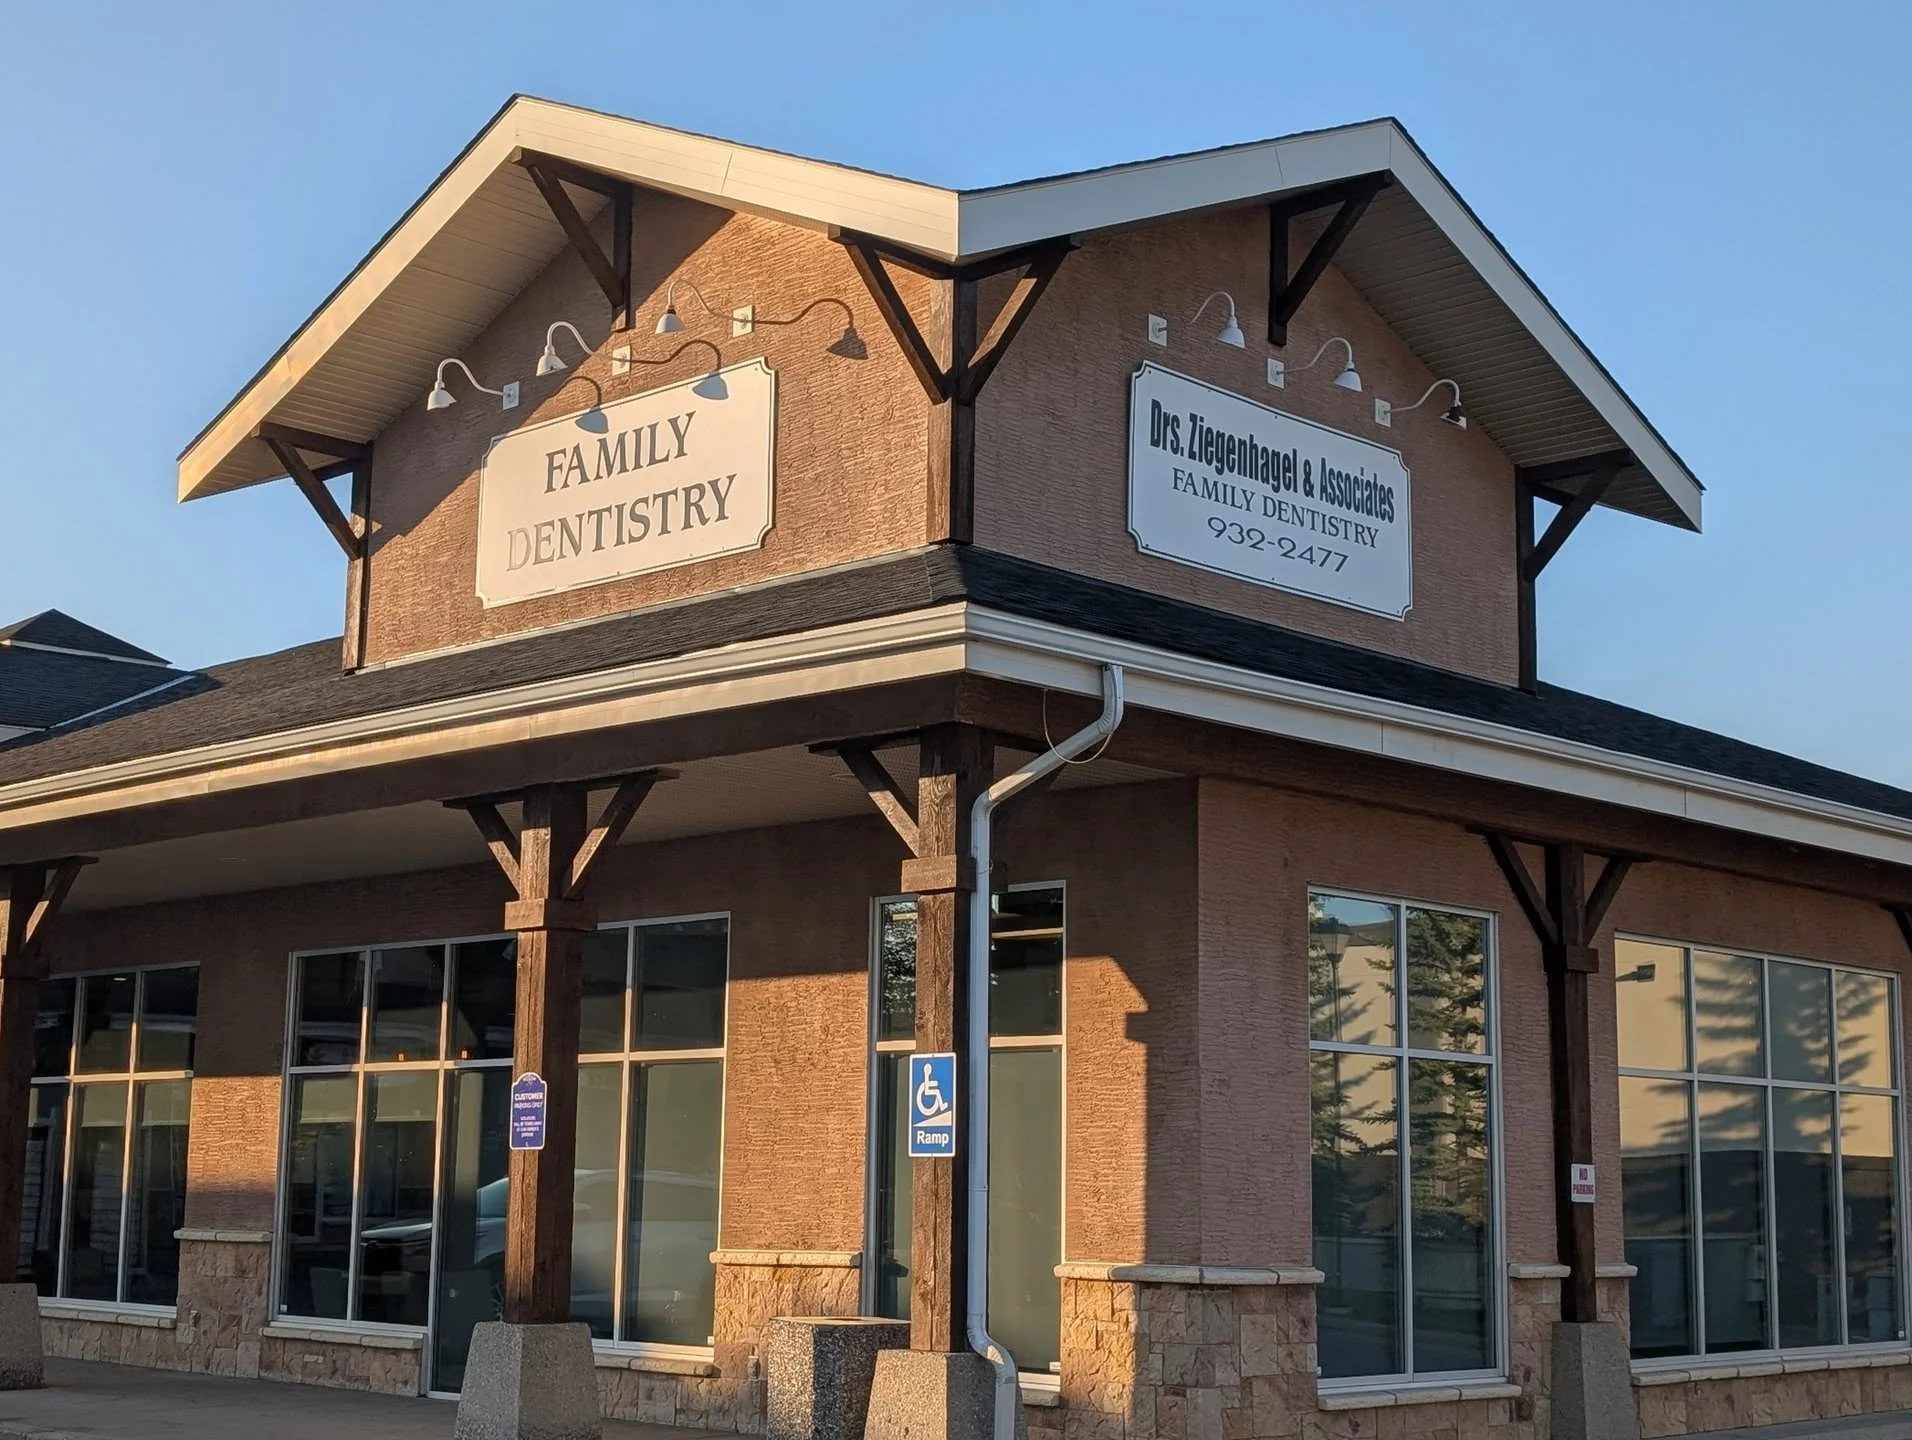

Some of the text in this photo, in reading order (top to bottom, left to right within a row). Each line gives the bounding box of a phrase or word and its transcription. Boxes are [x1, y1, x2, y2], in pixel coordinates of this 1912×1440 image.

[544, 410, 696, 494] FAMILY
[1150, 398, 1395, 524] Drs. Ziegenhagel & Associates
[506, 473, 737, 572] DENTISTRY
[1171, 467, 1379, 549] FAMILY DENTISTRY
[1207, 516, 1349, 572] 932-2477
[514, 1092, 544, 1101] CUSTOMER
[916, 1130, 949, 1147] Ramp
[1579, 1167, 1588, 1181] NO
